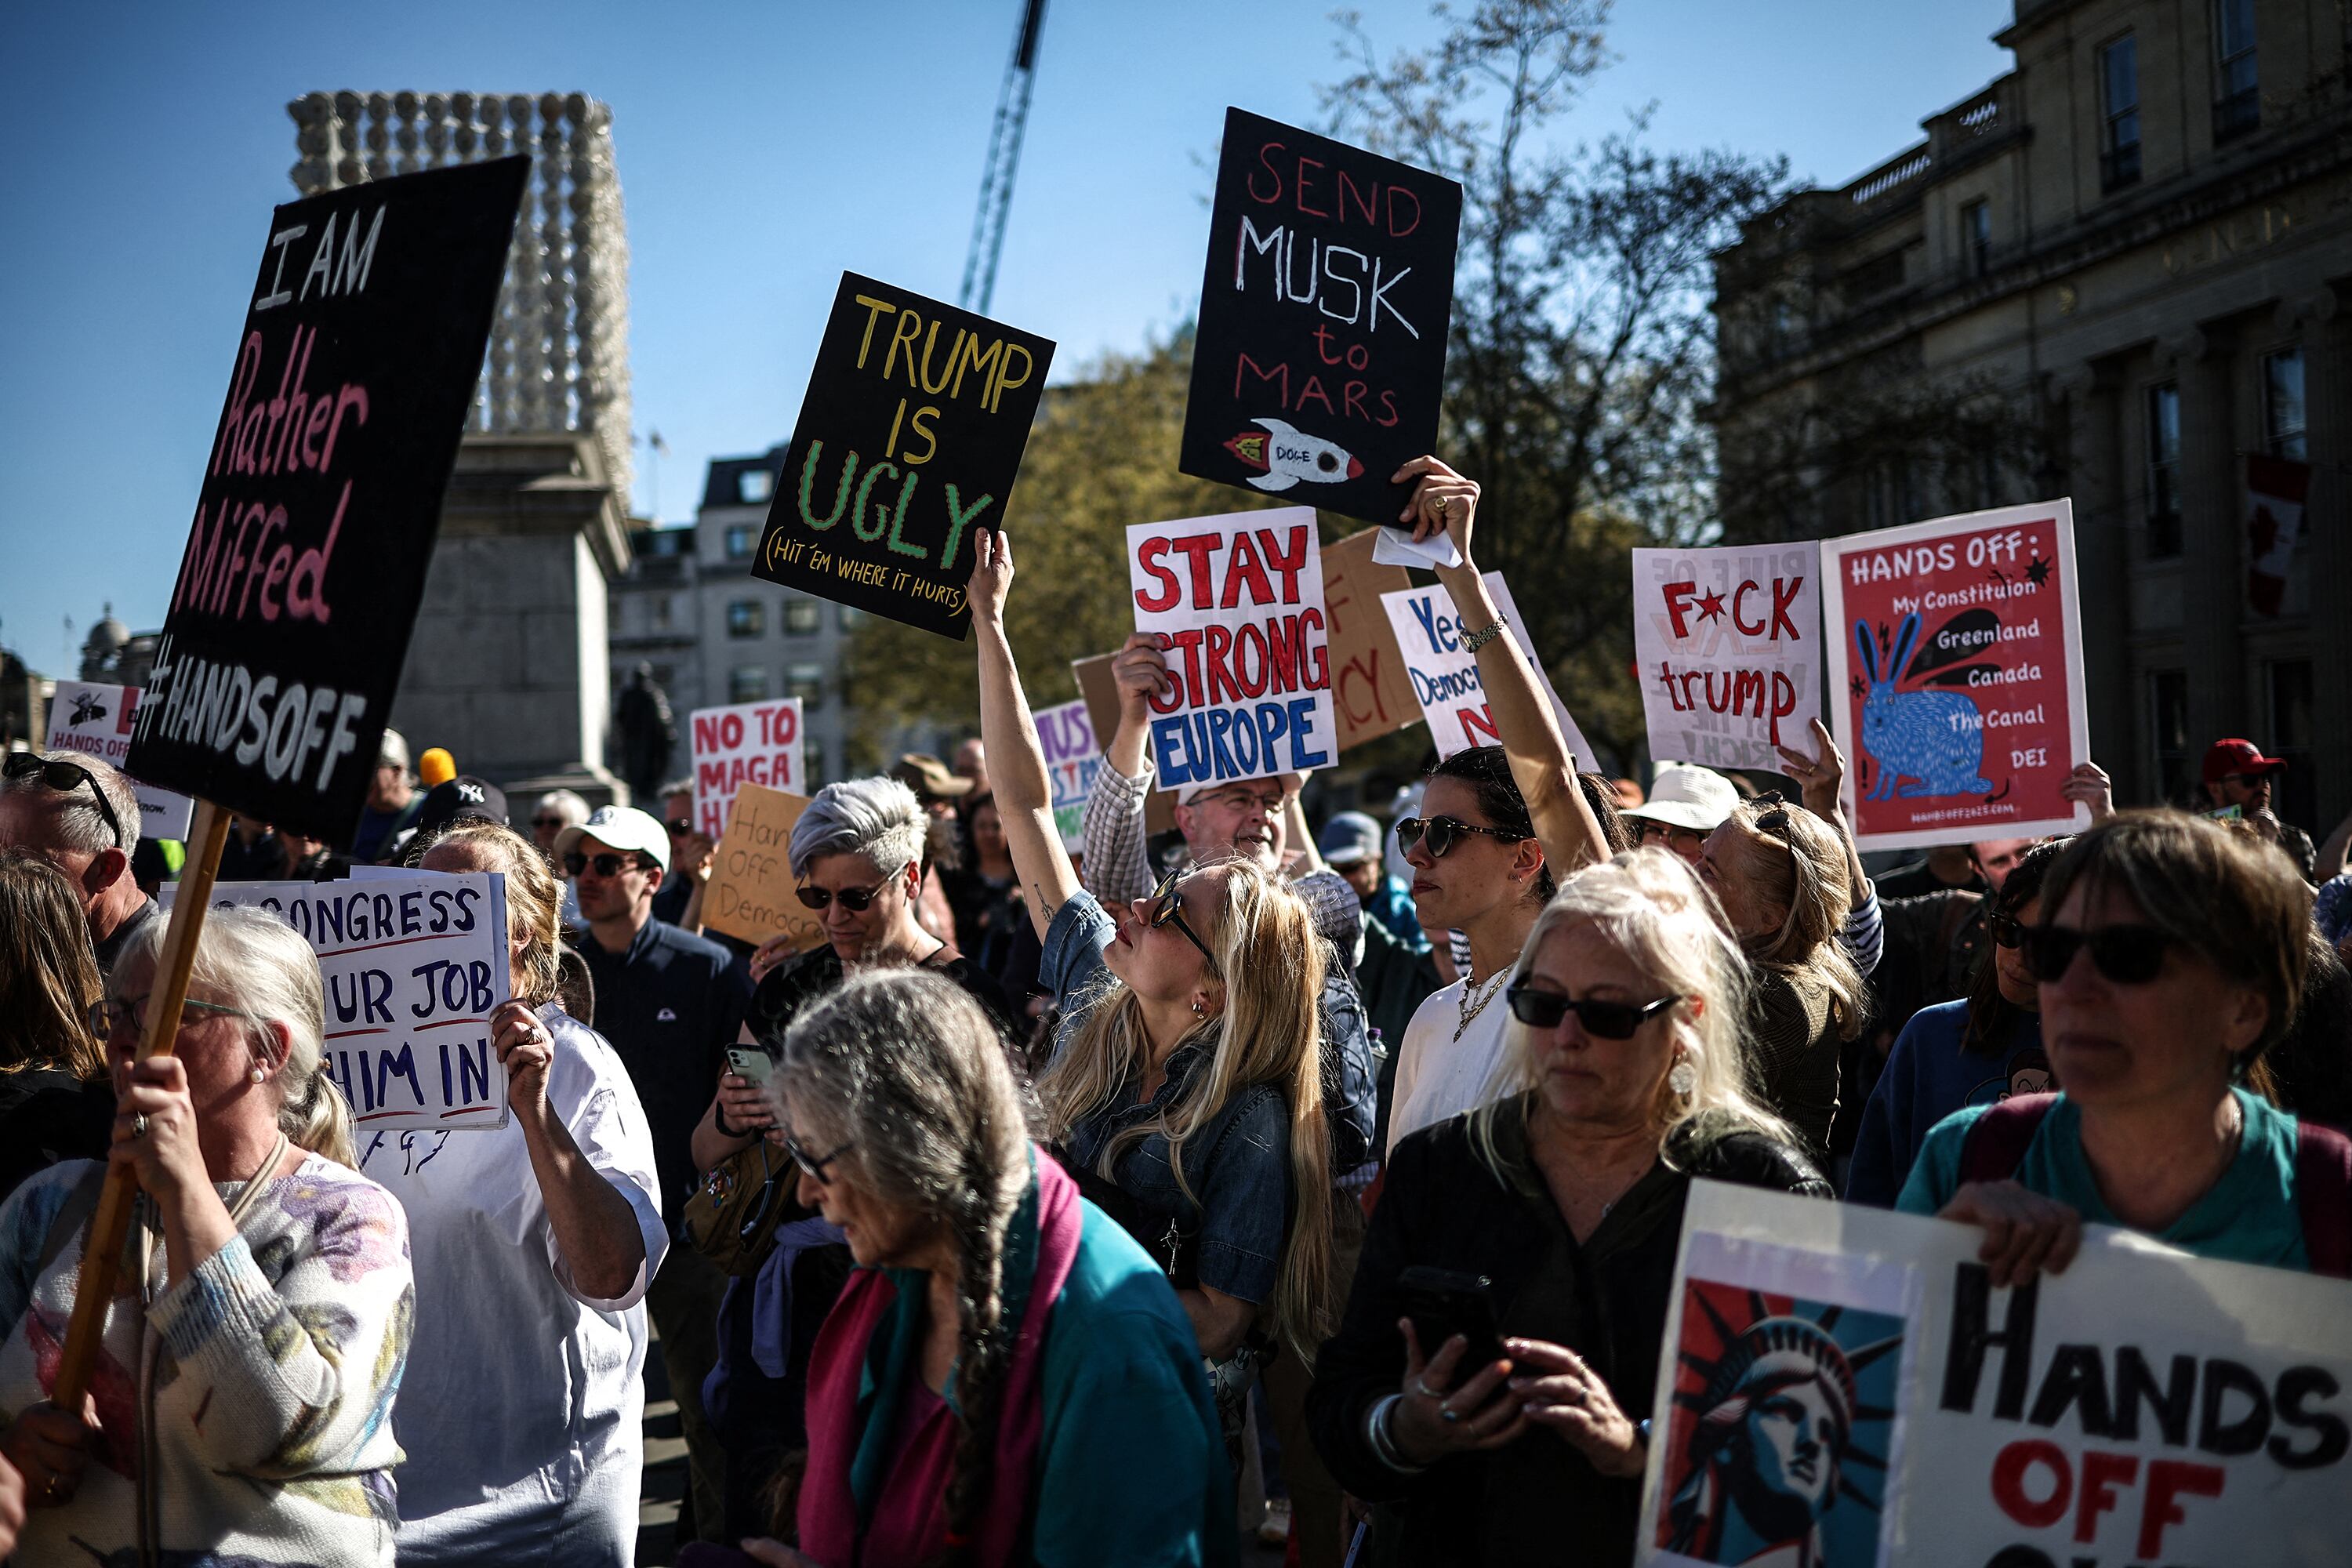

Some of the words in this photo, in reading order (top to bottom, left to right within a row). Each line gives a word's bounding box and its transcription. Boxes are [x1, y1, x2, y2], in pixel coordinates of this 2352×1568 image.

[1247, 142, 1421, 237] SEND
[256, 223, 309, 311] I
[299, 203, 387, 302] AM
[1234, 214, 1419, 339] MUSK
[855, 294, 1033, 413] TRUMP
[1312, 324, 1369, 371] to
[213, 324, 368, 476] Rather
[1236, 352, 1399, 427] MARS
[884, 398, 941, 464] IS
[1276, 445, 1312, 464] DOGE
[798, 439, 994, 570] UGLY
[837, 556, 889, 586] WHERE
[1134, 524, 1308, 613] STAY
[1850, 541, 1957, 586] HANDS
[1893, 593, 1921, 616] My
[1936, 618, 2040, 650] Greenland
[1148, 607, 1330, 713] STRONG
[1968, 663, 2042, 688] Canada
[136, 633, 368, 793] #HANDSOFF
[695, 713, 744, 755] NO
[754, 706, 797, 746] TO
[1660, 661, 1796, 746] trump
[1948, 710, 1984, 732] The
[1987, 703, 2045, 729] Canal
[53, 731, 103, 755] HANDS
[698, 753, 790, 798] MAGA
[1151, 697, 1328, 788] EUROPE
[2010, 747, 2049, 769] DEI
[728, 850, 778, 884] Off
[323, 967, 396, 1025] UR
[411, 960, 495, 1019] JOB
[438, 1038, 490, 1108] IN
[1940, 1261, 2352, 1471] HANDS
[1991, 1439, 2227, 1561] OFF
